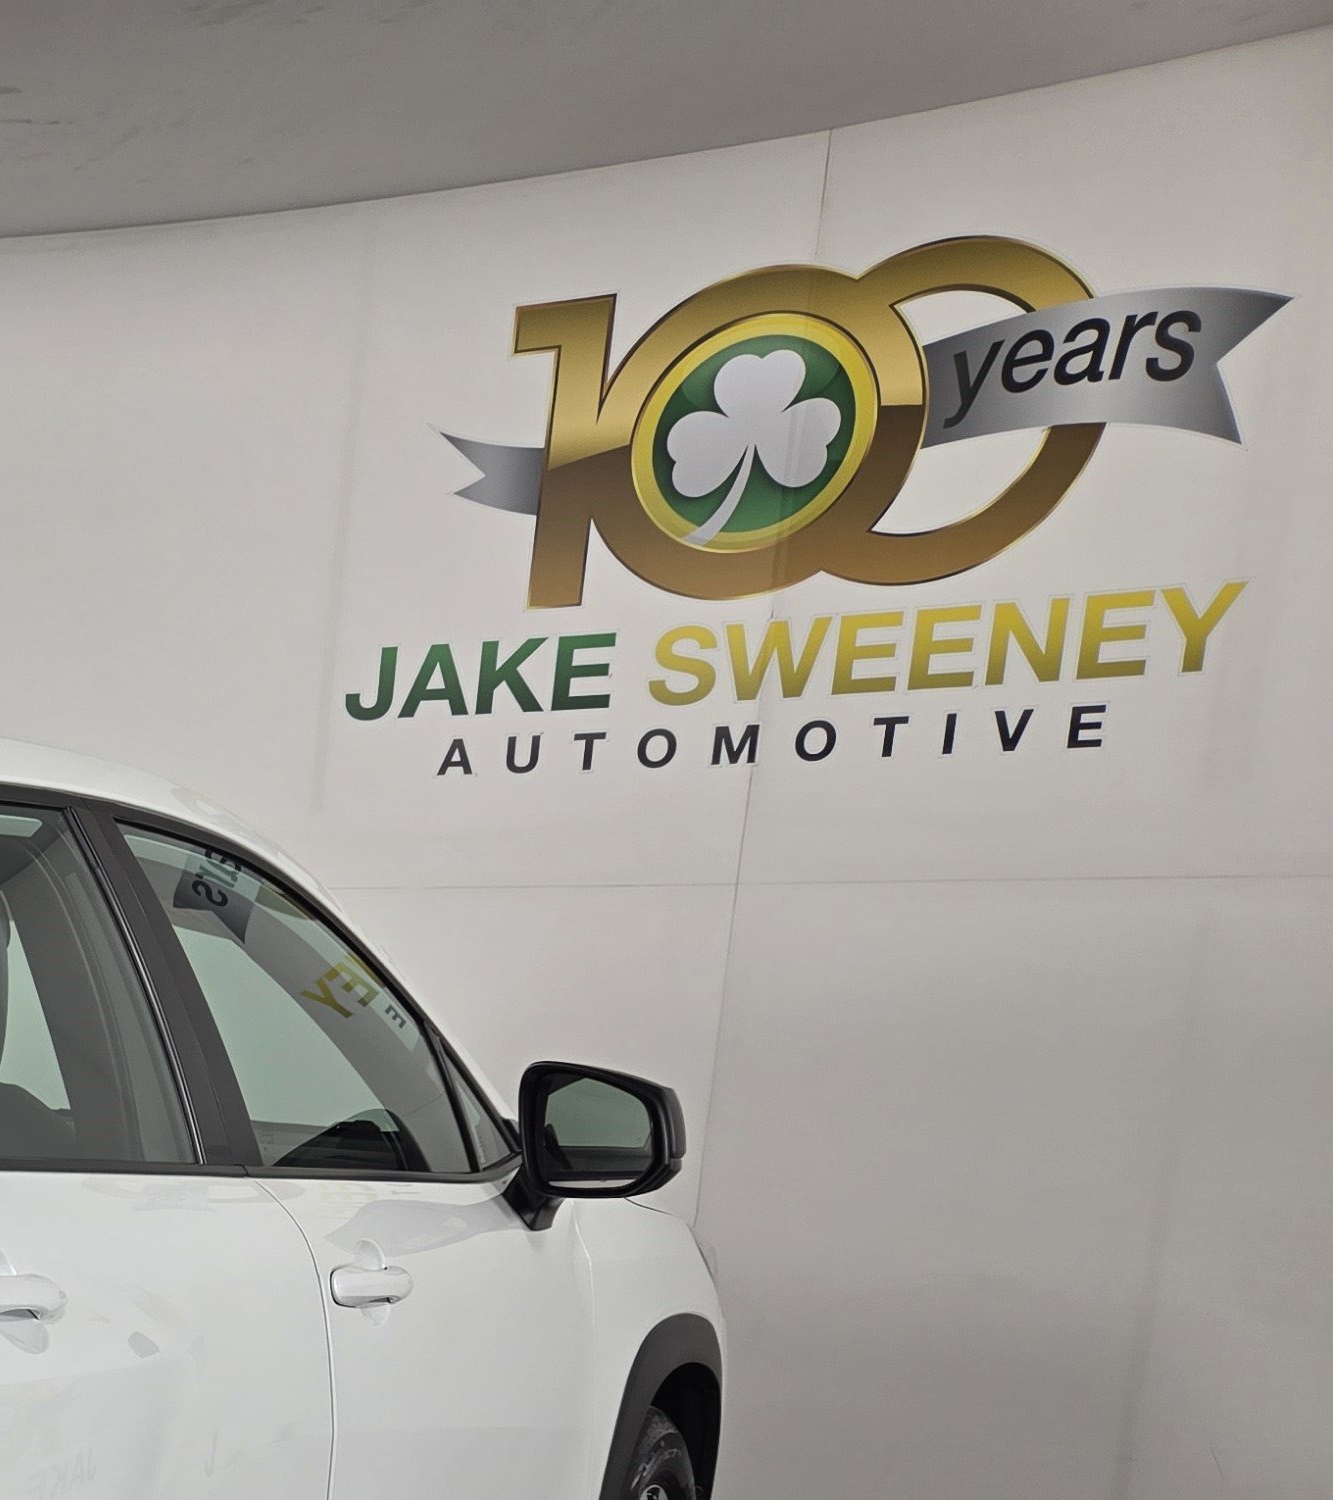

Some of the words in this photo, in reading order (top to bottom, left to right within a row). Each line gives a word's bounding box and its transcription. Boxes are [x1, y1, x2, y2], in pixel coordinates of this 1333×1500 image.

[942, 307, 1201, 428] years
[344, 631, 618, 721] JAKE
[647, 579, 1248, 706] SWEENEY
[436, 703, 1108, 777] AUTOMOTIVE
